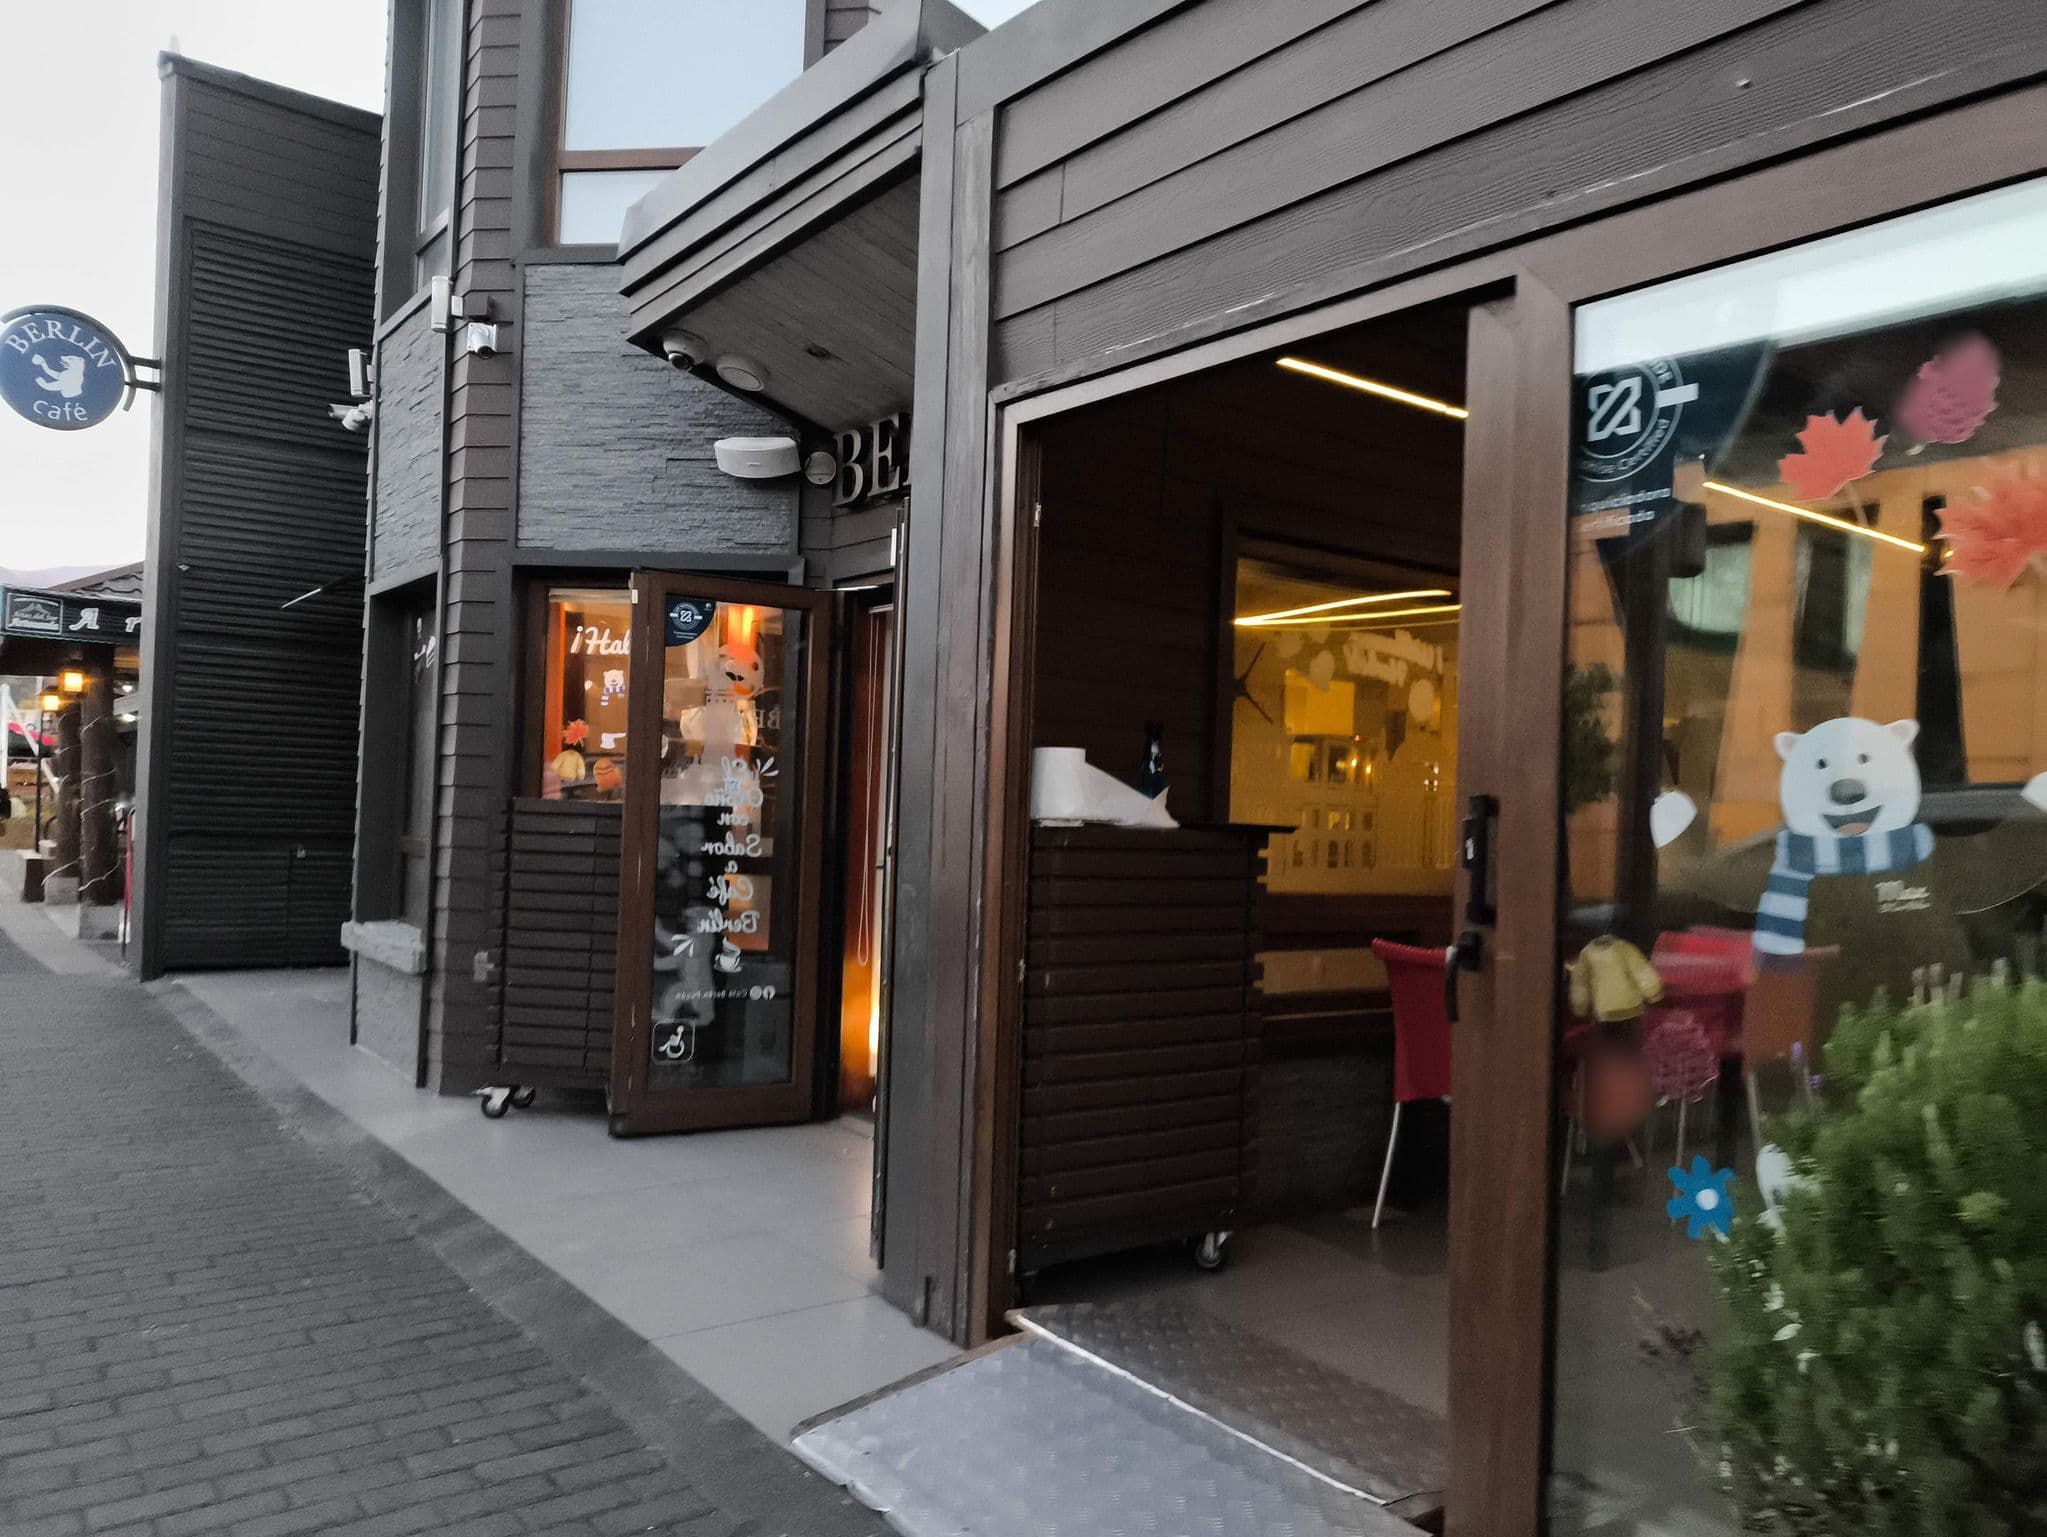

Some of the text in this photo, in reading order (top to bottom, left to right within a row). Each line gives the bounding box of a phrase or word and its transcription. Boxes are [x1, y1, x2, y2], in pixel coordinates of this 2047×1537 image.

[4, 319, 117, 368] BERLIN
[32, 400, 88, 422] café
[832, 411, 912, 507] BE
